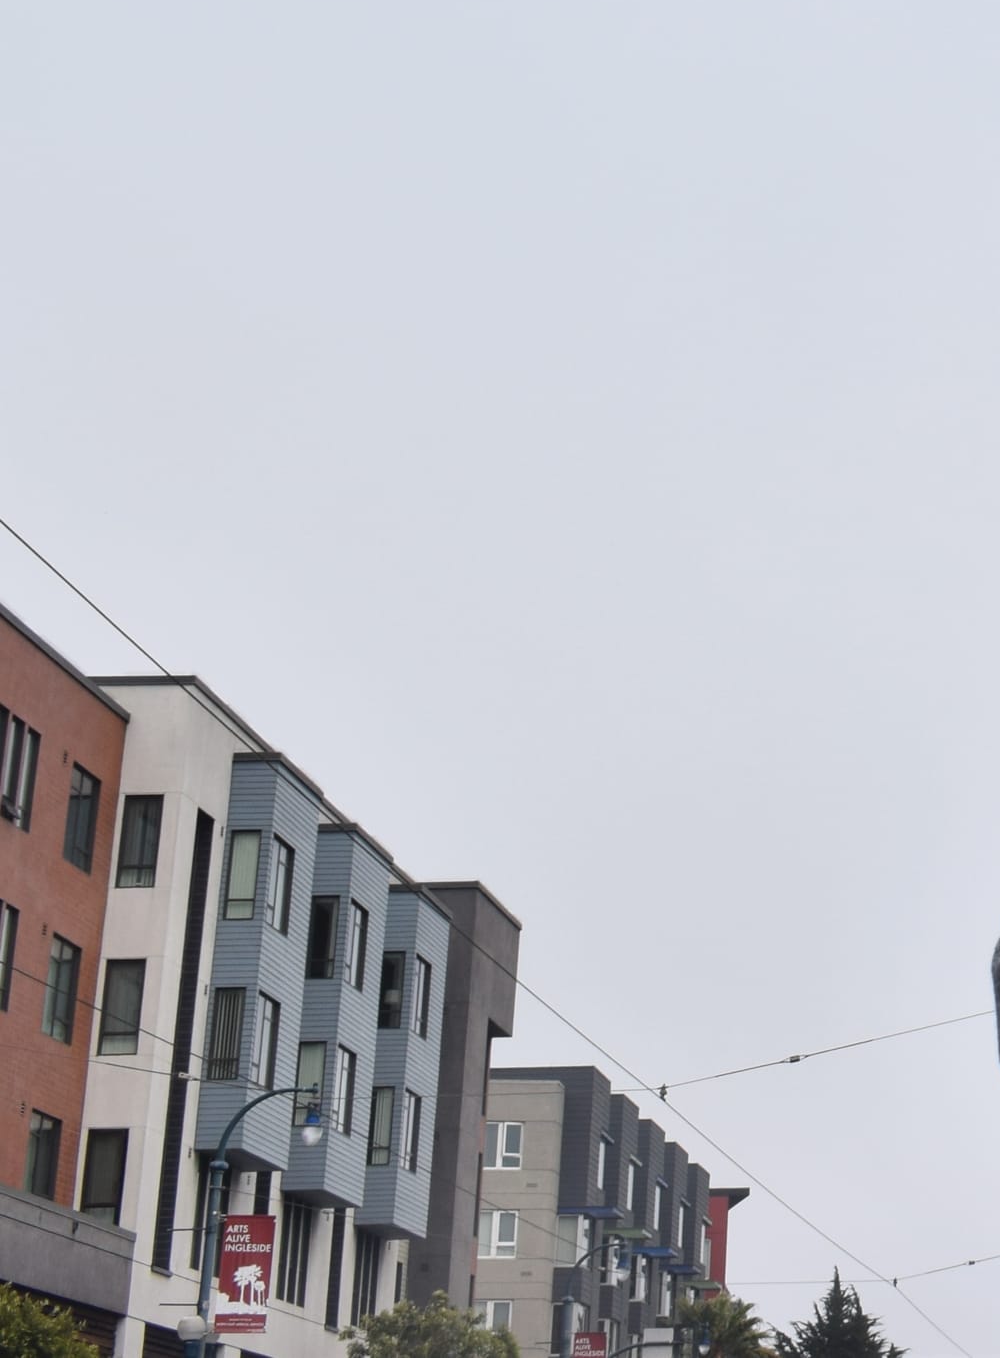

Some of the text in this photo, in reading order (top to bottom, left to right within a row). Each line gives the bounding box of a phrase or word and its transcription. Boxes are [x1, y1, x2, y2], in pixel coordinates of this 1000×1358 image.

[226, 1224, 249, 1233] ARTS
[225, 1234, 251, 1243] ALIVE
[224, 1243, 272, 1253] INGLESIDE
